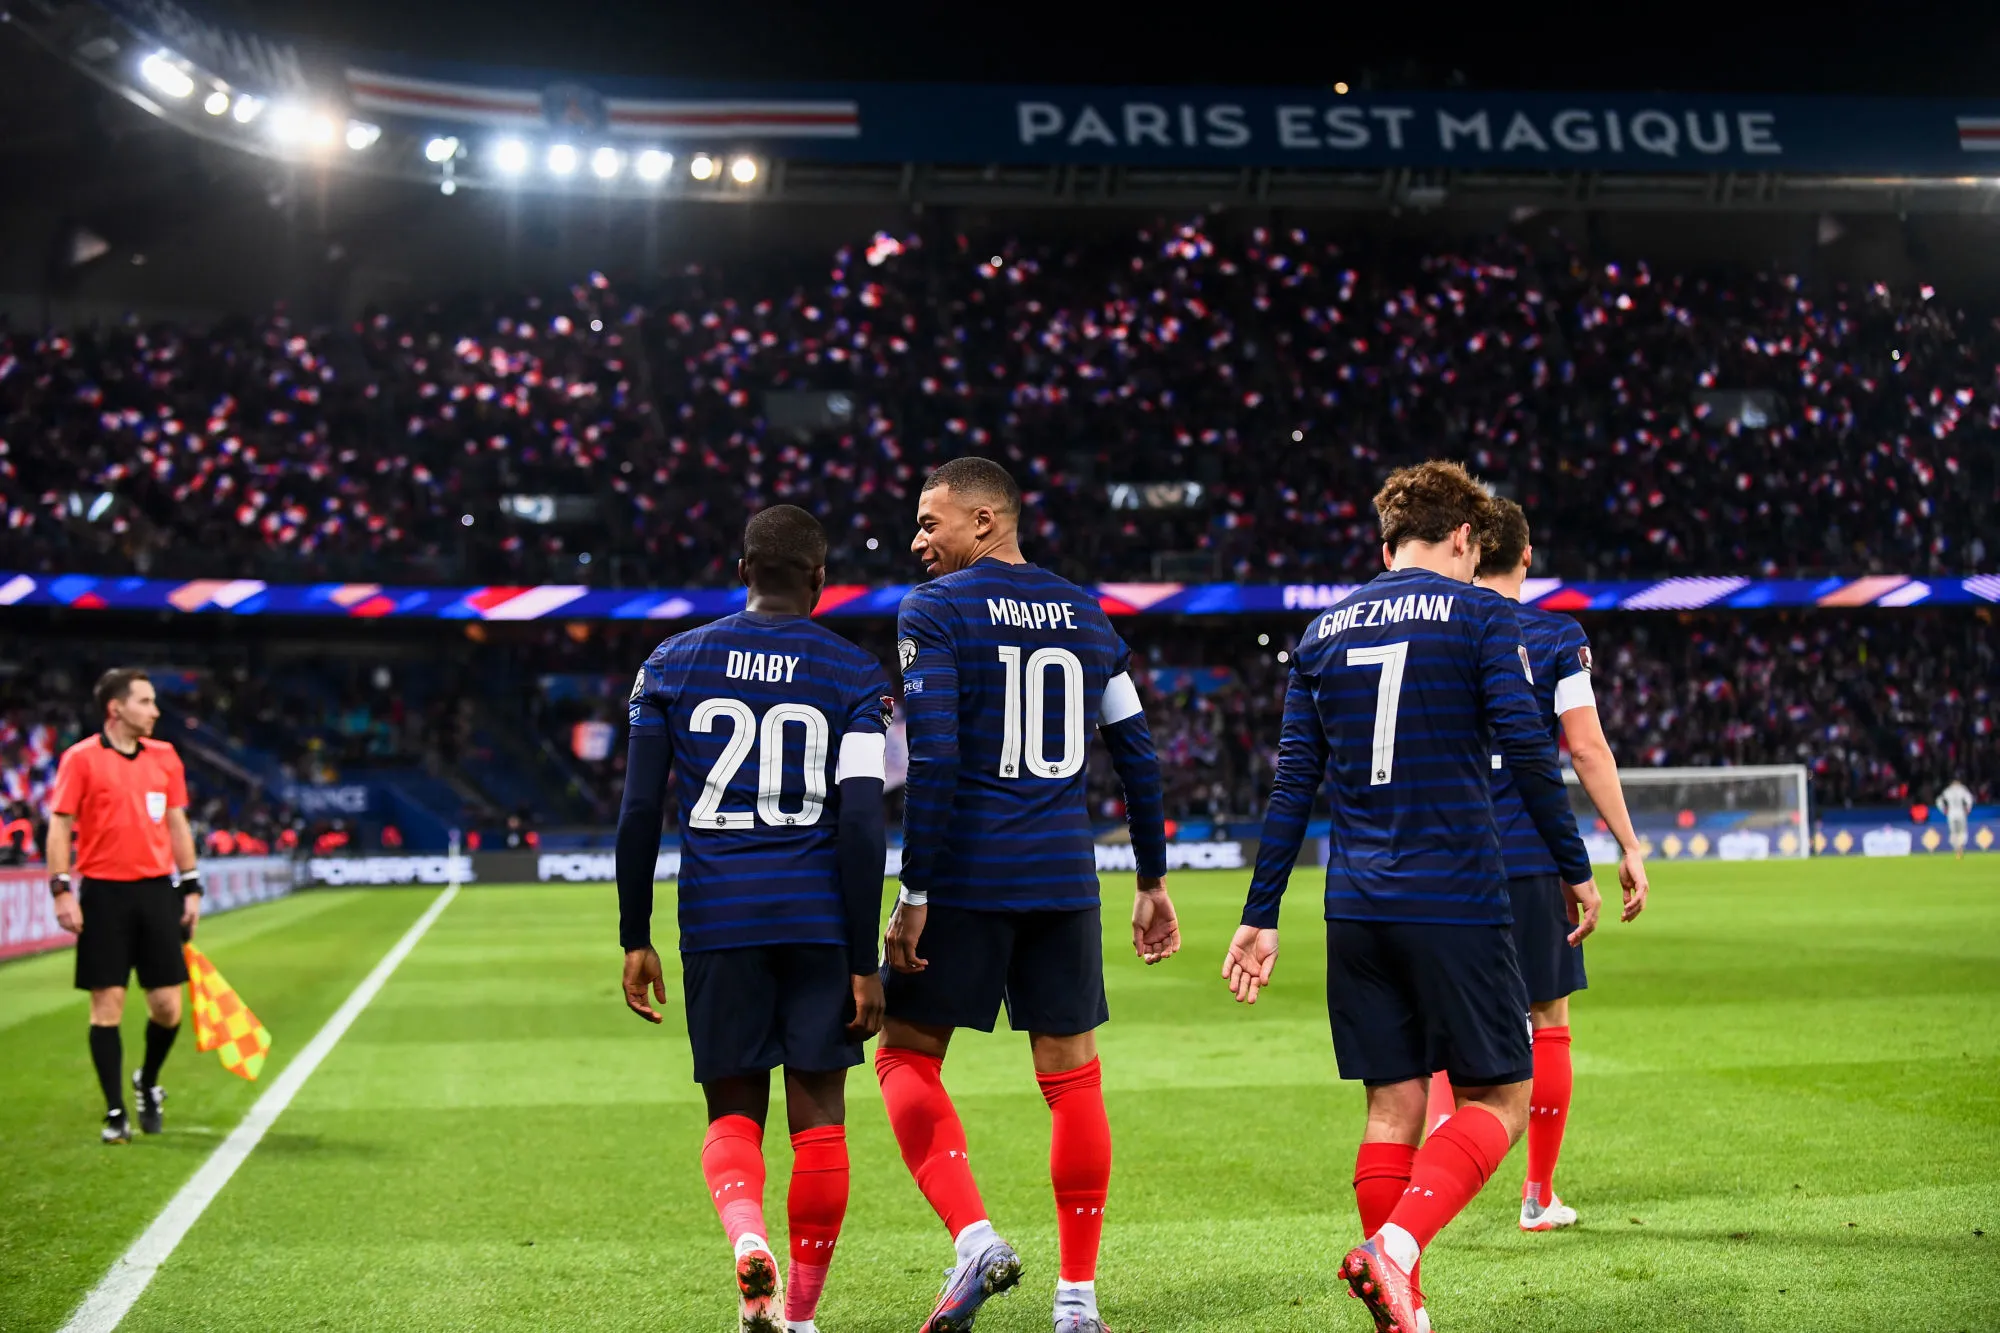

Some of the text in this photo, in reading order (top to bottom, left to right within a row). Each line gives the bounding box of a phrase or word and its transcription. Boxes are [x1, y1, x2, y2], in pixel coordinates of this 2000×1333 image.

[1016, 102, 1784, 158] PARIS EST MAGIQUE
[986, 597, 1078, 630] MBAPPE
[1317, 594, 1454, 639] GRIEZMANN
[726, 650, 799, 683] DIABY
[997, 645, 1085, 779] 10
[1346, 640, 1409, 786] 7
[688, 697, 829, 829] 20
